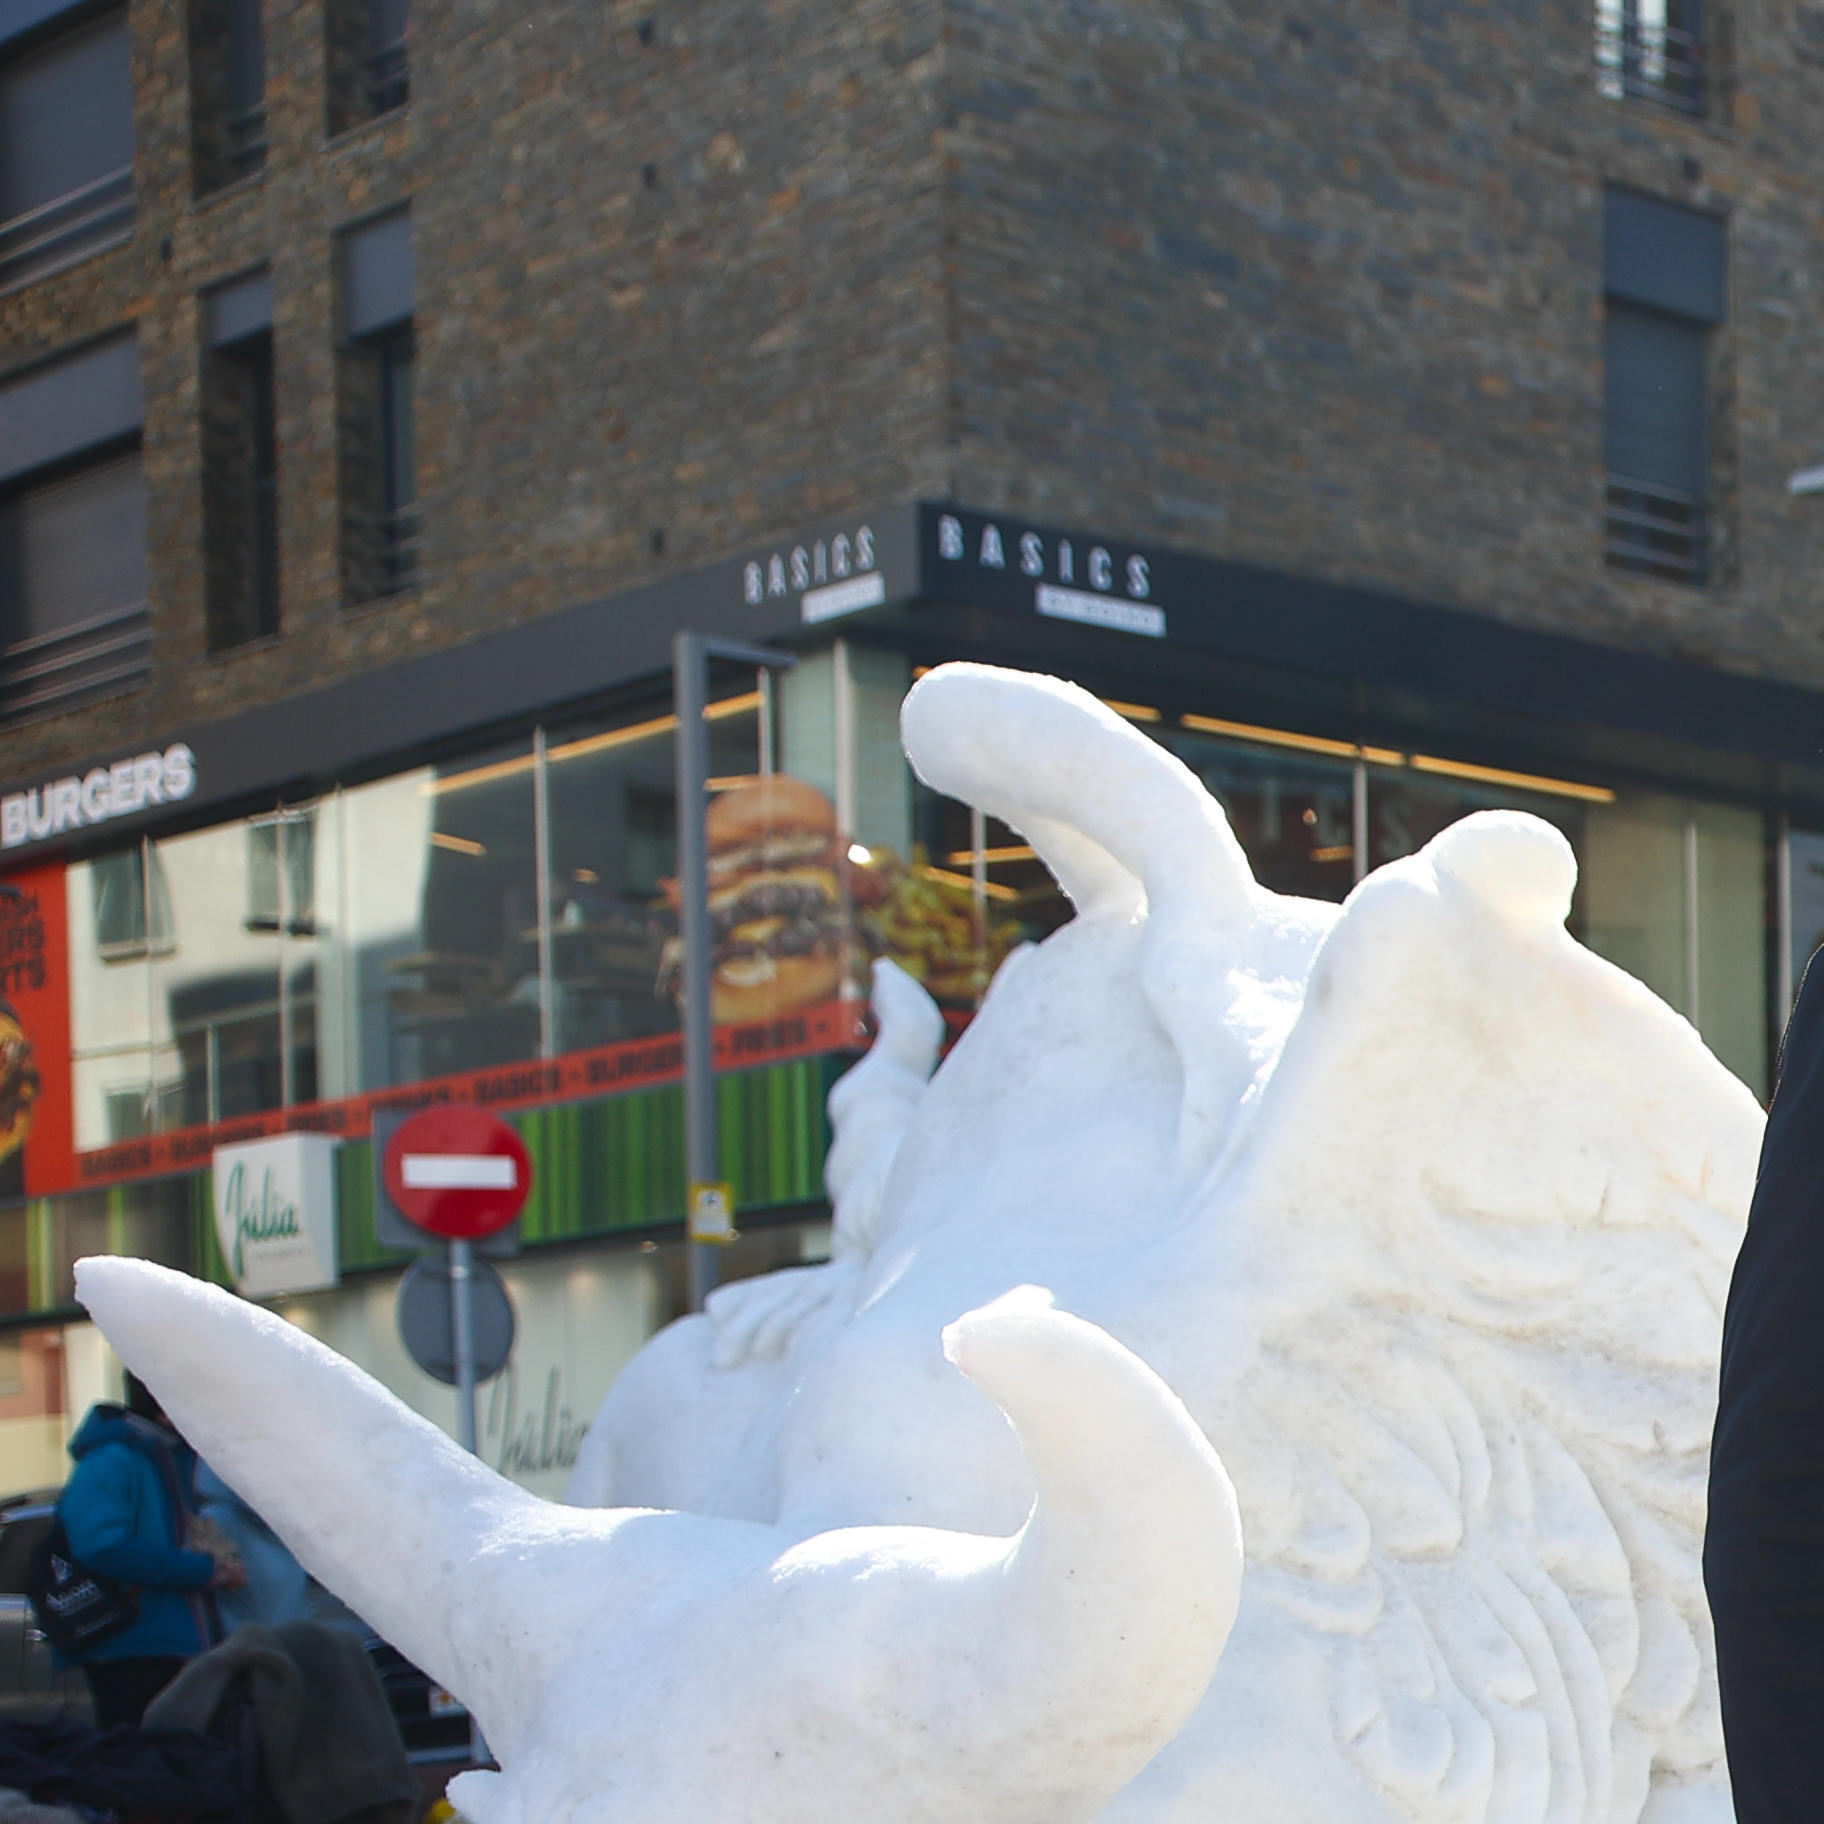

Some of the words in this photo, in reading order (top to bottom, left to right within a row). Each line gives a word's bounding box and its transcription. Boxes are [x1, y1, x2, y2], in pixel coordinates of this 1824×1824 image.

[744, 524, 876, 605] BASICS
[937, 513, 1151, 599] BASICS
[1, 742, 197, 849] BURGERS
[586, 1041, 685, 1086] BURGER
